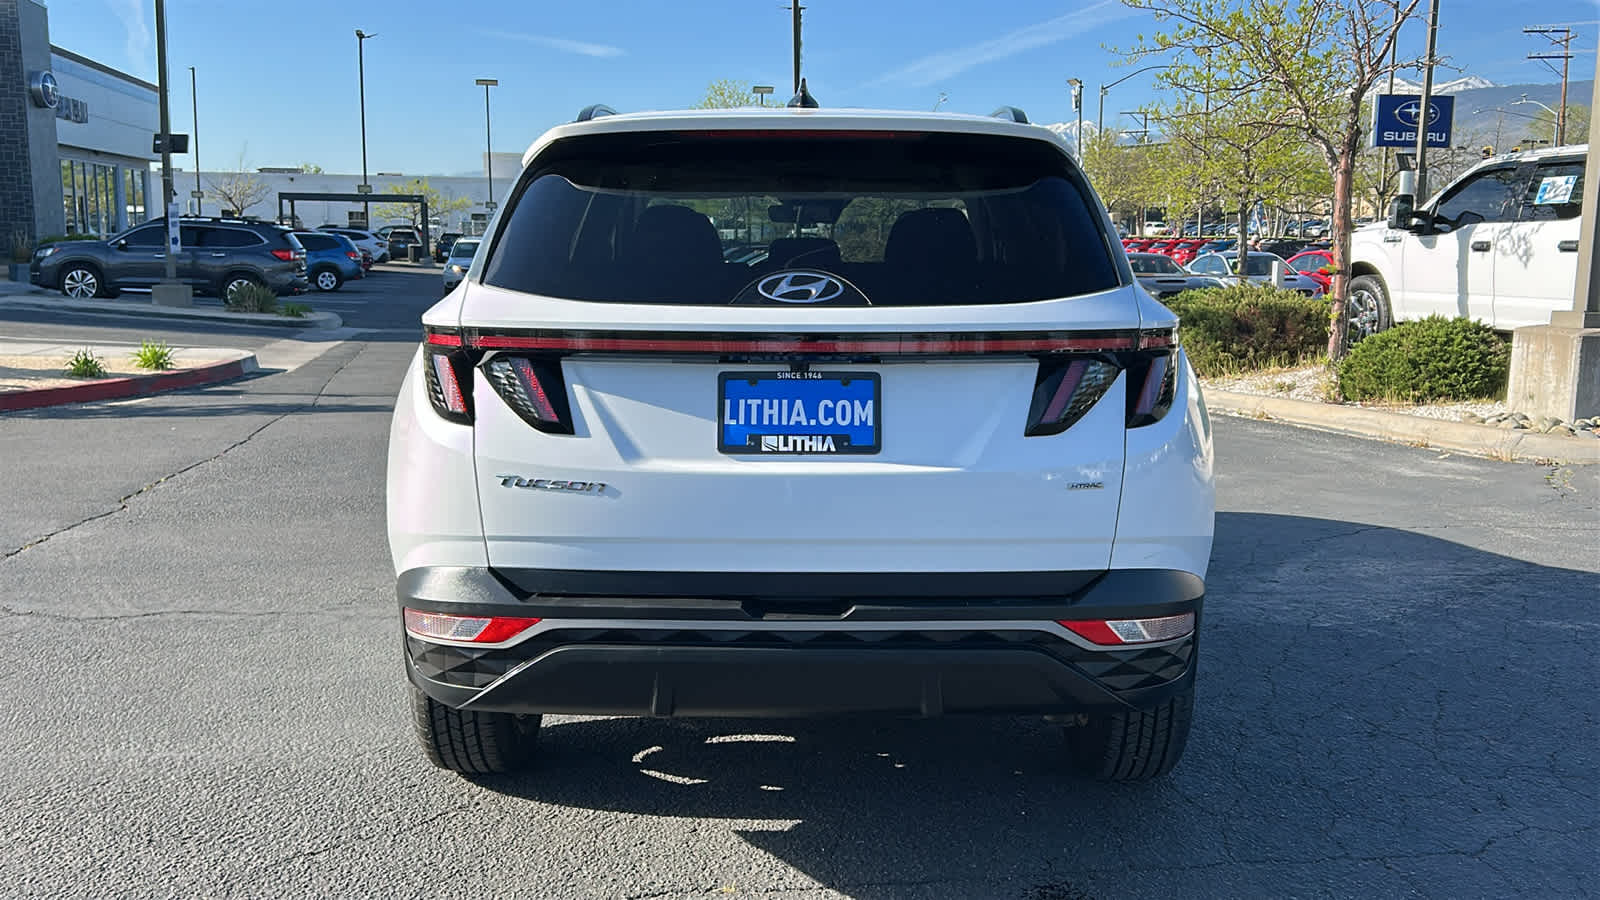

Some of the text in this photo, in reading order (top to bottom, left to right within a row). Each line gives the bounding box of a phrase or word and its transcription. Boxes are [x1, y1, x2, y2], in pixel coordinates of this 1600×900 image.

[1383, 131, 1446, 142] SUBRU
[776, 371, 822, 379] SINCE 1946
[723, 398, 874, 426] LITHIA.COM
[778, 435, 836, 452] LITHIA
